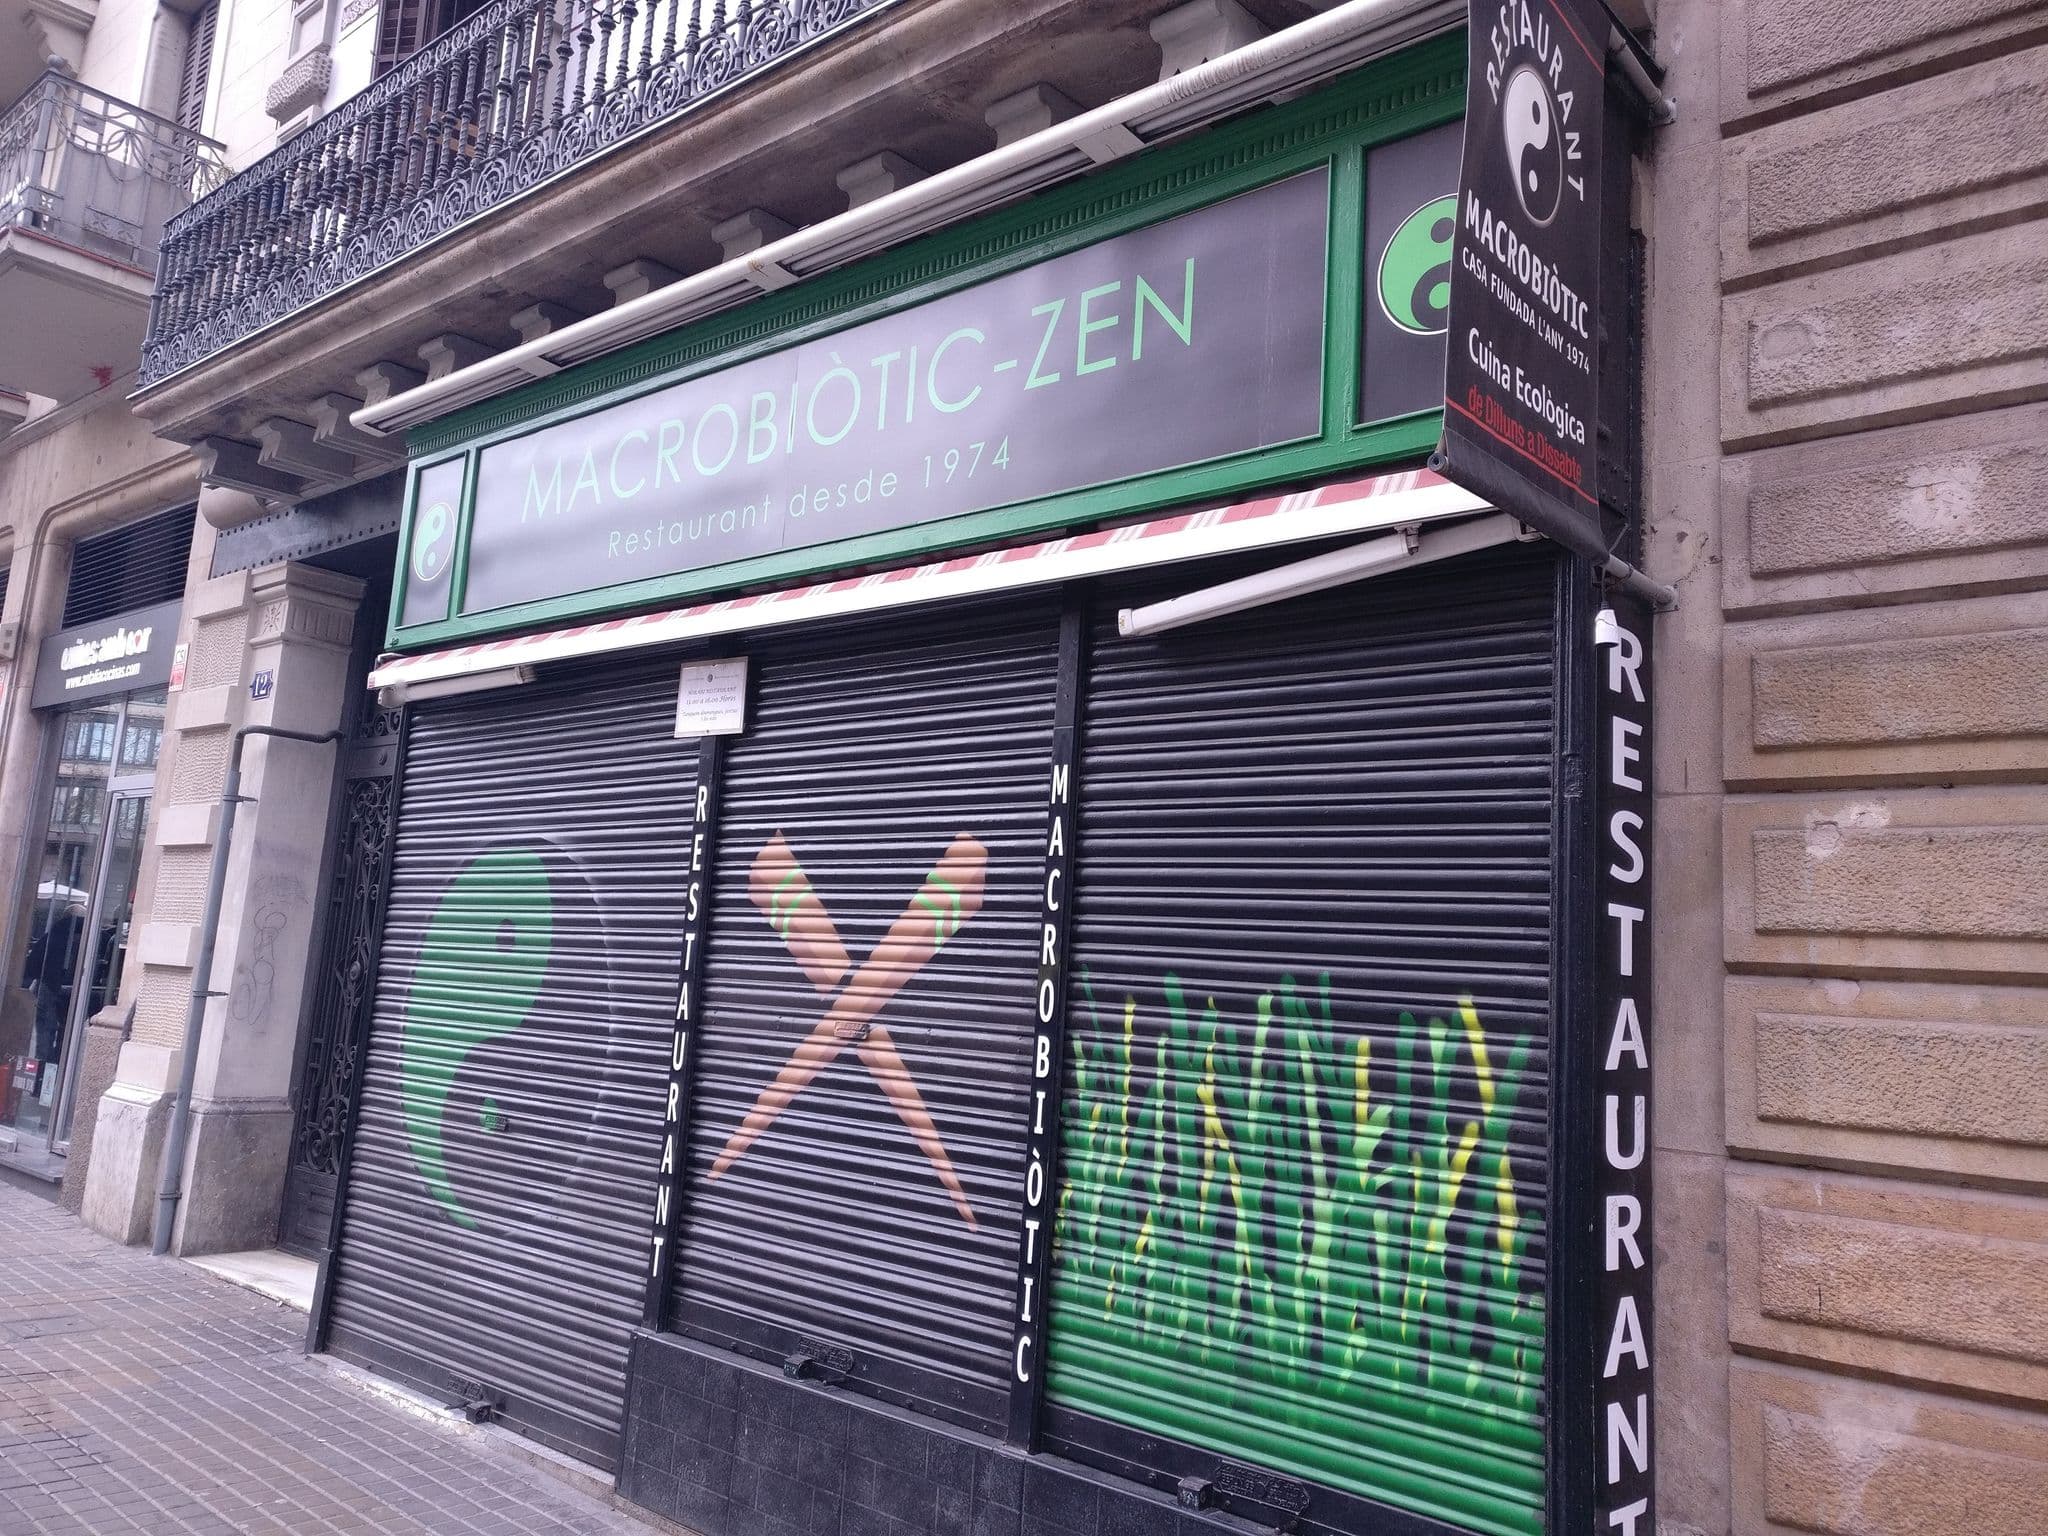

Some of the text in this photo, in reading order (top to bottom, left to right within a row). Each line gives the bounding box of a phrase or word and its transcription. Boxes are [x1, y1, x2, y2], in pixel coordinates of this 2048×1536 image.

[1486, 0, 1584, 201] RESTAURANT
[1462, 247, 1590, 375] CASA FUNDADA L'ANY 1974
[1465, 189, 1589, 339] MACROBIÒTIC
[521, 257, 1196, 523] MACROBIÒTIC-ZEN
[1468, 327, 1585, 446] Cuina Ecològica
[1468, 384, 1582, 486] de Dilluns a Dissabte
[607, 435, 1012, 559] Restaurant desde 1974
[255, 674, 268, 696] 12
[652, 785, 708, 1278] RESTAURANT
[1016, 763, 1069, 1385] MACROBIÒTIC
